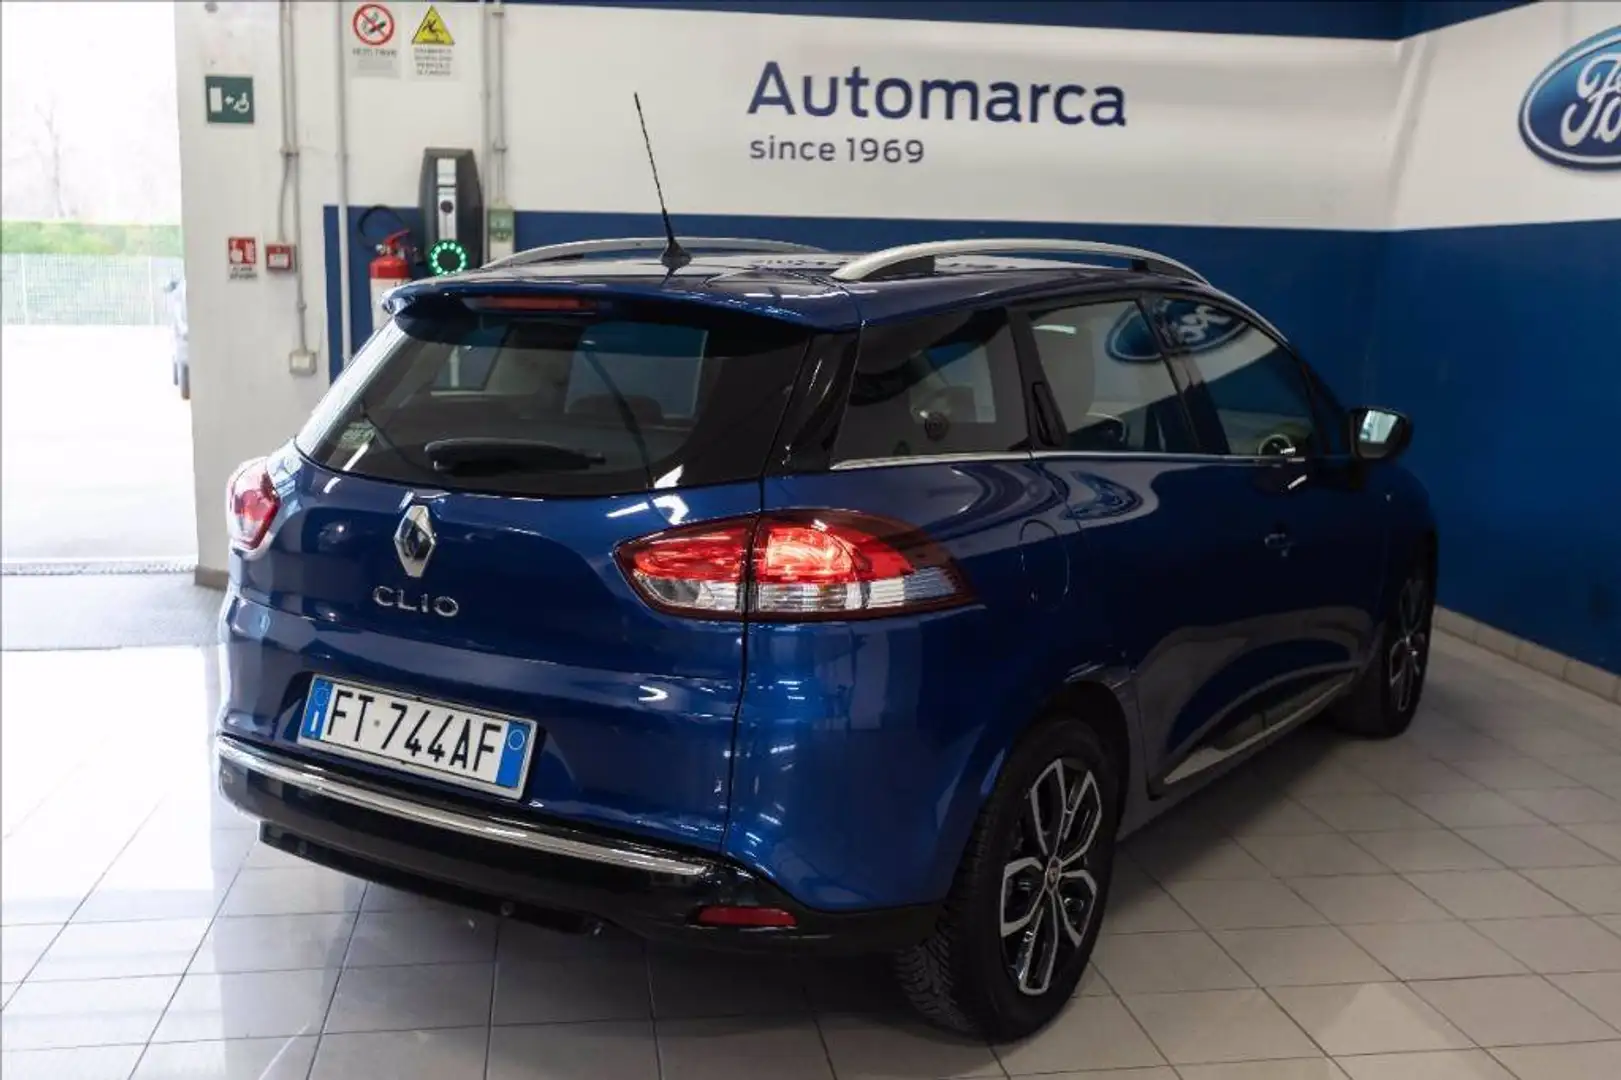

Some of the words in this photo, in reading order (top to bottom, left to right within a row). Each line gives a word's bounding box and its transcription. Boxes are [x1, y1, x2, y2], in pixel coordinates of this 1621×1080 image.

[747, 60, 1127, 127] Automarca
[1560, 53, 1621, 147] Fo
[749, 134, 836, 161] since
[846, 137, 926, 163] 1969
[373, 585, 459, 617] CLIO
